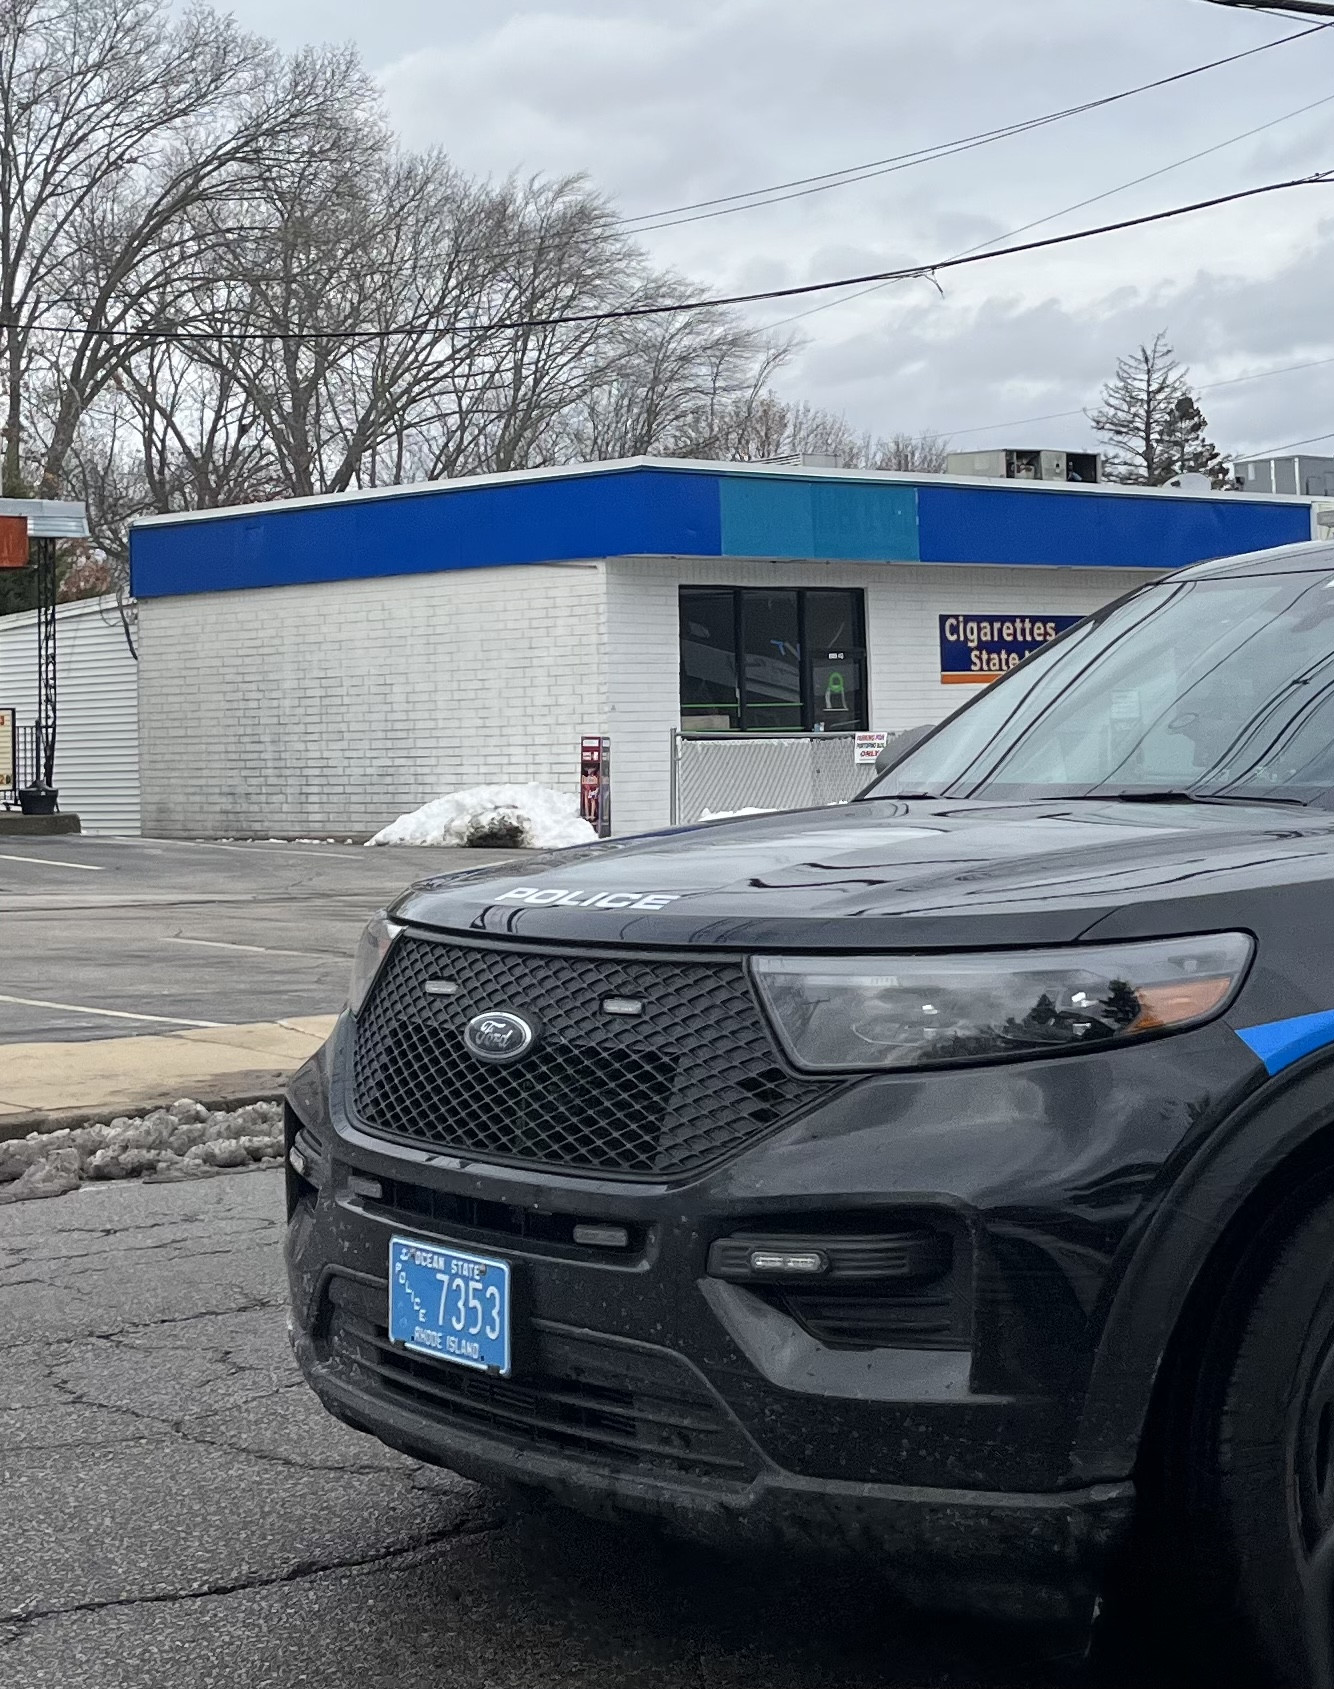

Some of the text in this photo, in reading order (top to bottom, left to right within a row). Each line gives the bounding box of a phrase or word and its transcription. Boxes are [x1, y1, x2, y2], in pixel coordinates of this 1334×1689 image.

[944, 616, 1057, 647] Cigarettes
[970, 649, 1020, 671] State
[494, 887, 681, 910] POLICE
[475, 1020, 513, 1048] Ford
[414, 1251, 481, 1280] OCEAN STATE
[395, 1261, 427, 1323] POLICE
[436, 1272, 500, 1340] 7353
[414, 1326, 480, 1359] RHODE ISLAND
